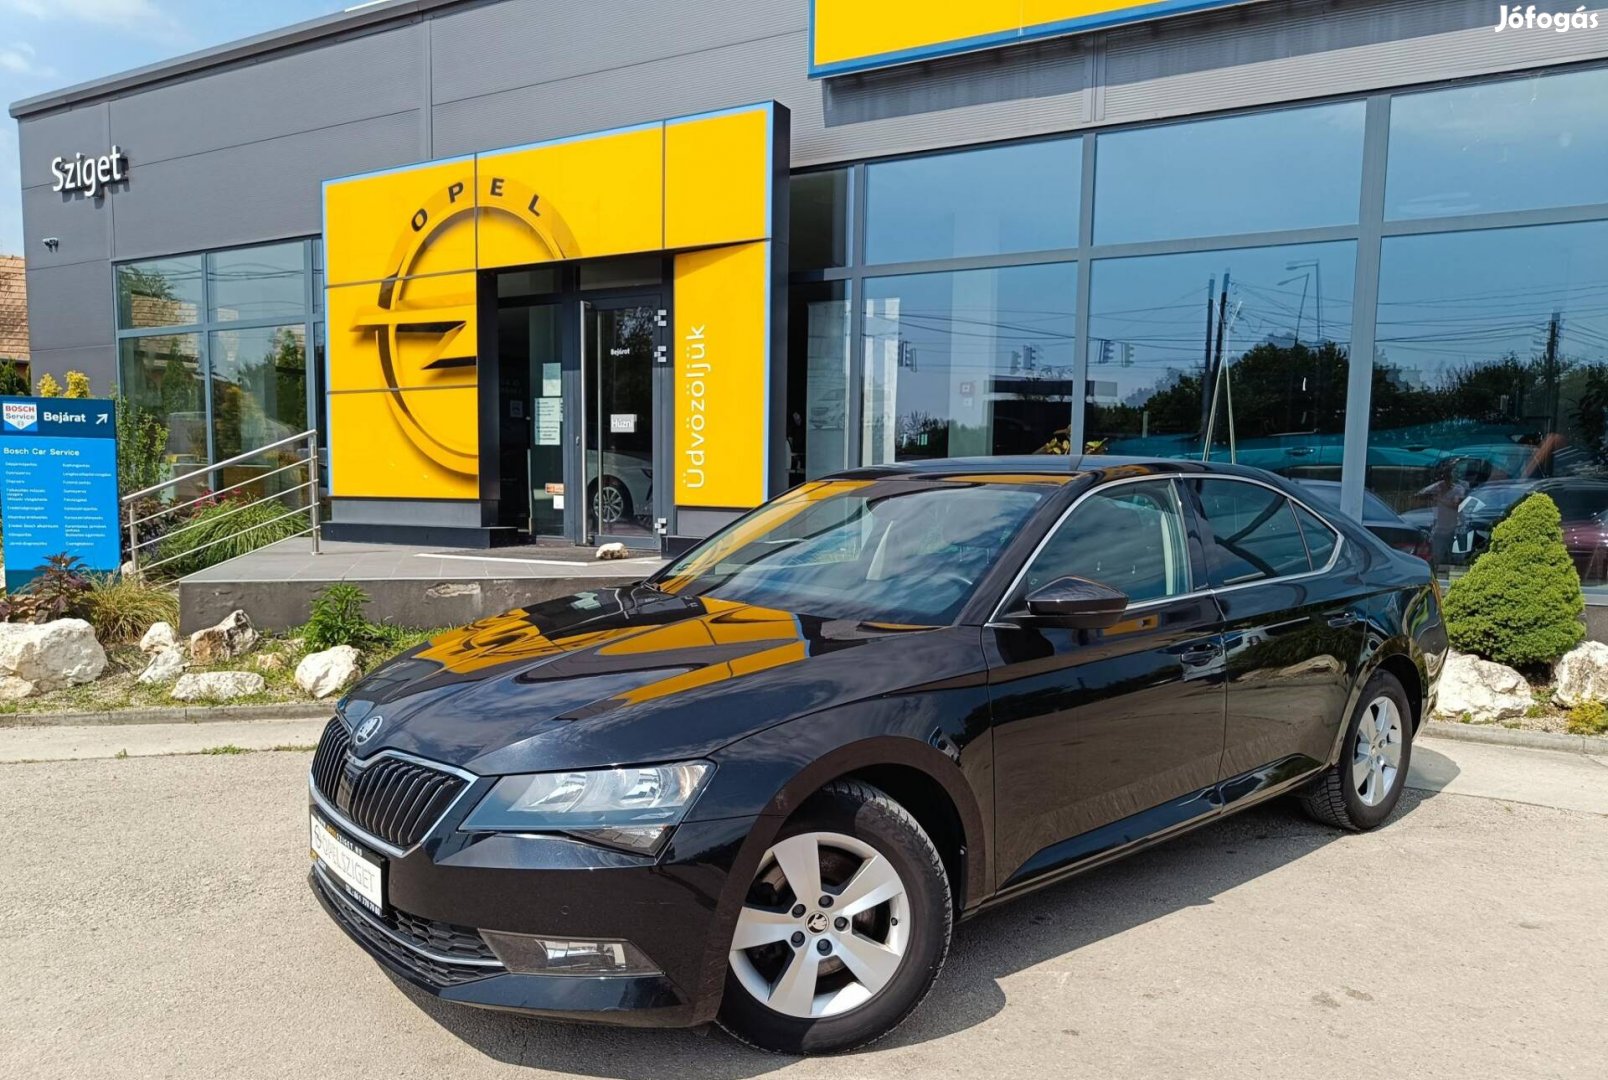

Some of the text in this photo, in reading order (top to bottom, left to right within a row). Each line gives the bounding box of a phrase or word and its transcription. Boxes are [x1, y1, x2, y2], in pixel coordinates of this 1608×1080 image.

[51, 144, 121, 197] Sziget
[411, 177, 541, 232] OPEL
[5, 405, 35, 413] BOSCH
[682, 324, 712, 489] Üdvözöljük
[5, 412, 35, 420] Service
[43, 411, 87, 424] Bejárat
[3, 447, 80, 456] Bosch Car Service
